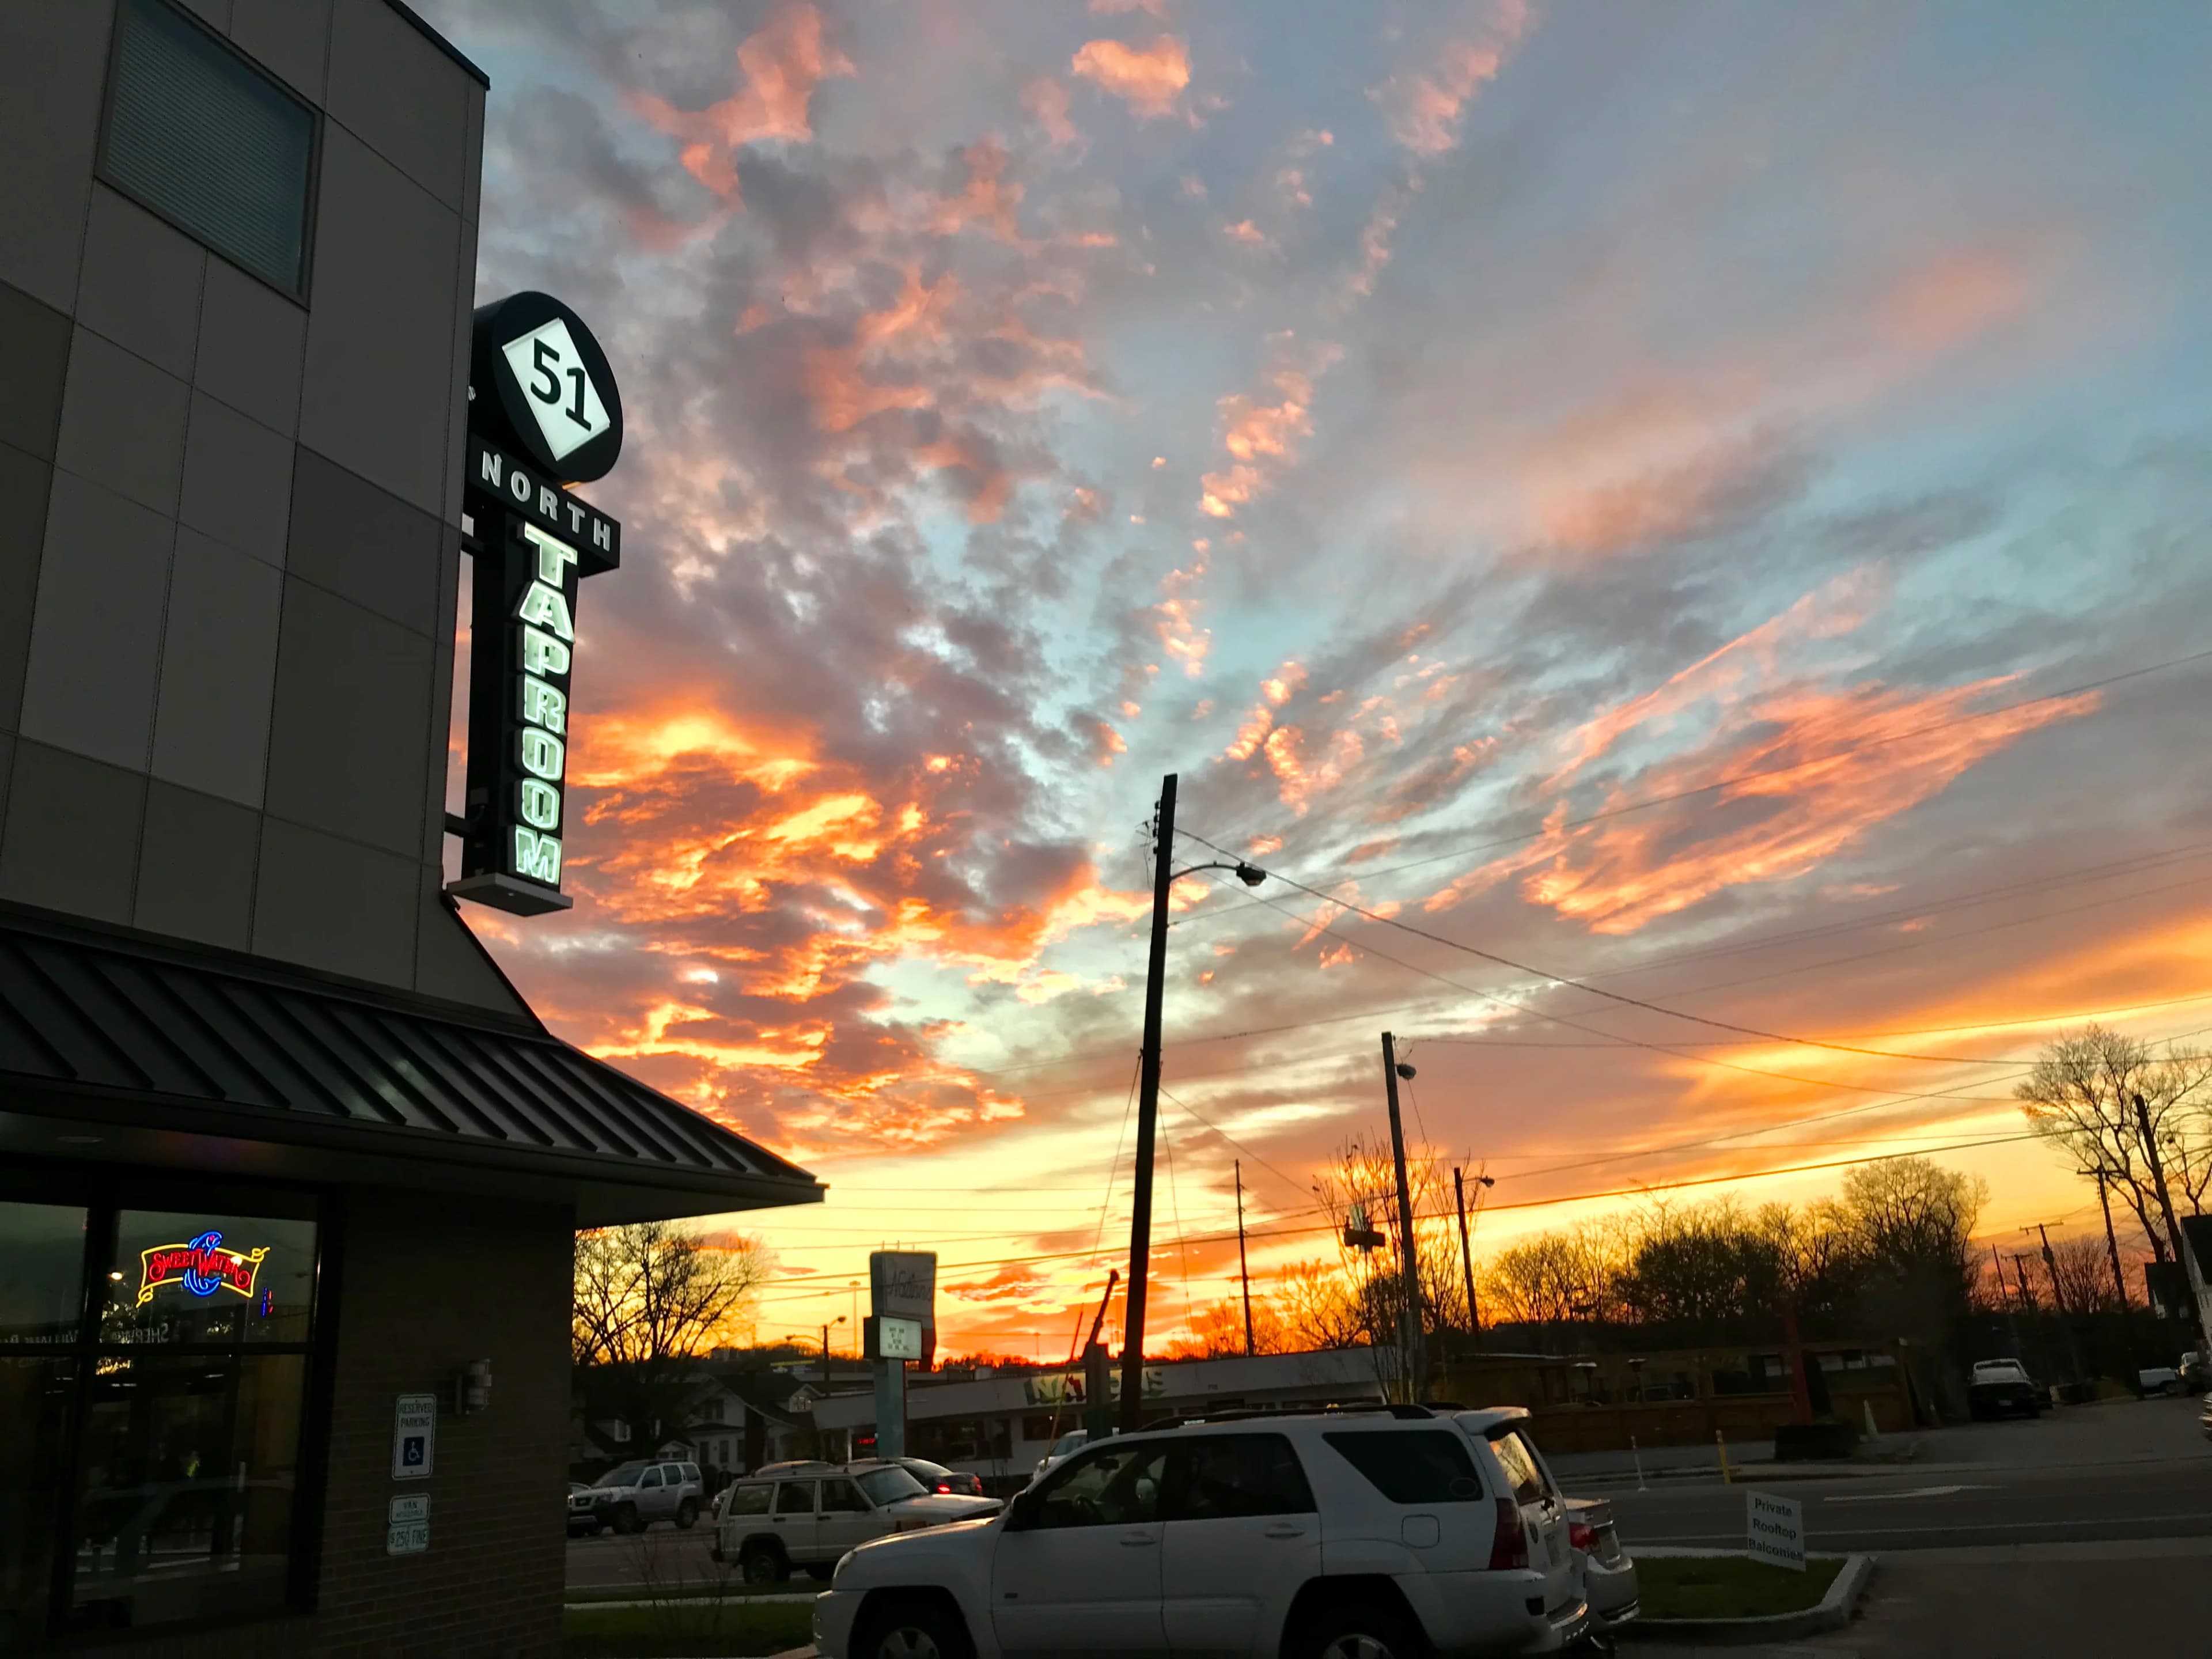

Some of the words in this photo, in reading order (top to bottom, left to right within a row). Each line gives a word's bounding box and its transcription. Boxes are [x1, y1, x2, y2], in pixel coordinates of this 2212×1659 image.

[531, 338, 592, 431] 51
[482, 450, 611, 551] NORTH
[516, 521, 577, 886] TAPROOM
[399, 1403, 433, 1414] RESERVED
[401, 1417, 429, 1427] PARKING
[1755, 1498, 1791, 1516] Private
[1753, 1518, 1796, 1540] Rooftop
[1749, 1537, 1803, 1561] Balconies
